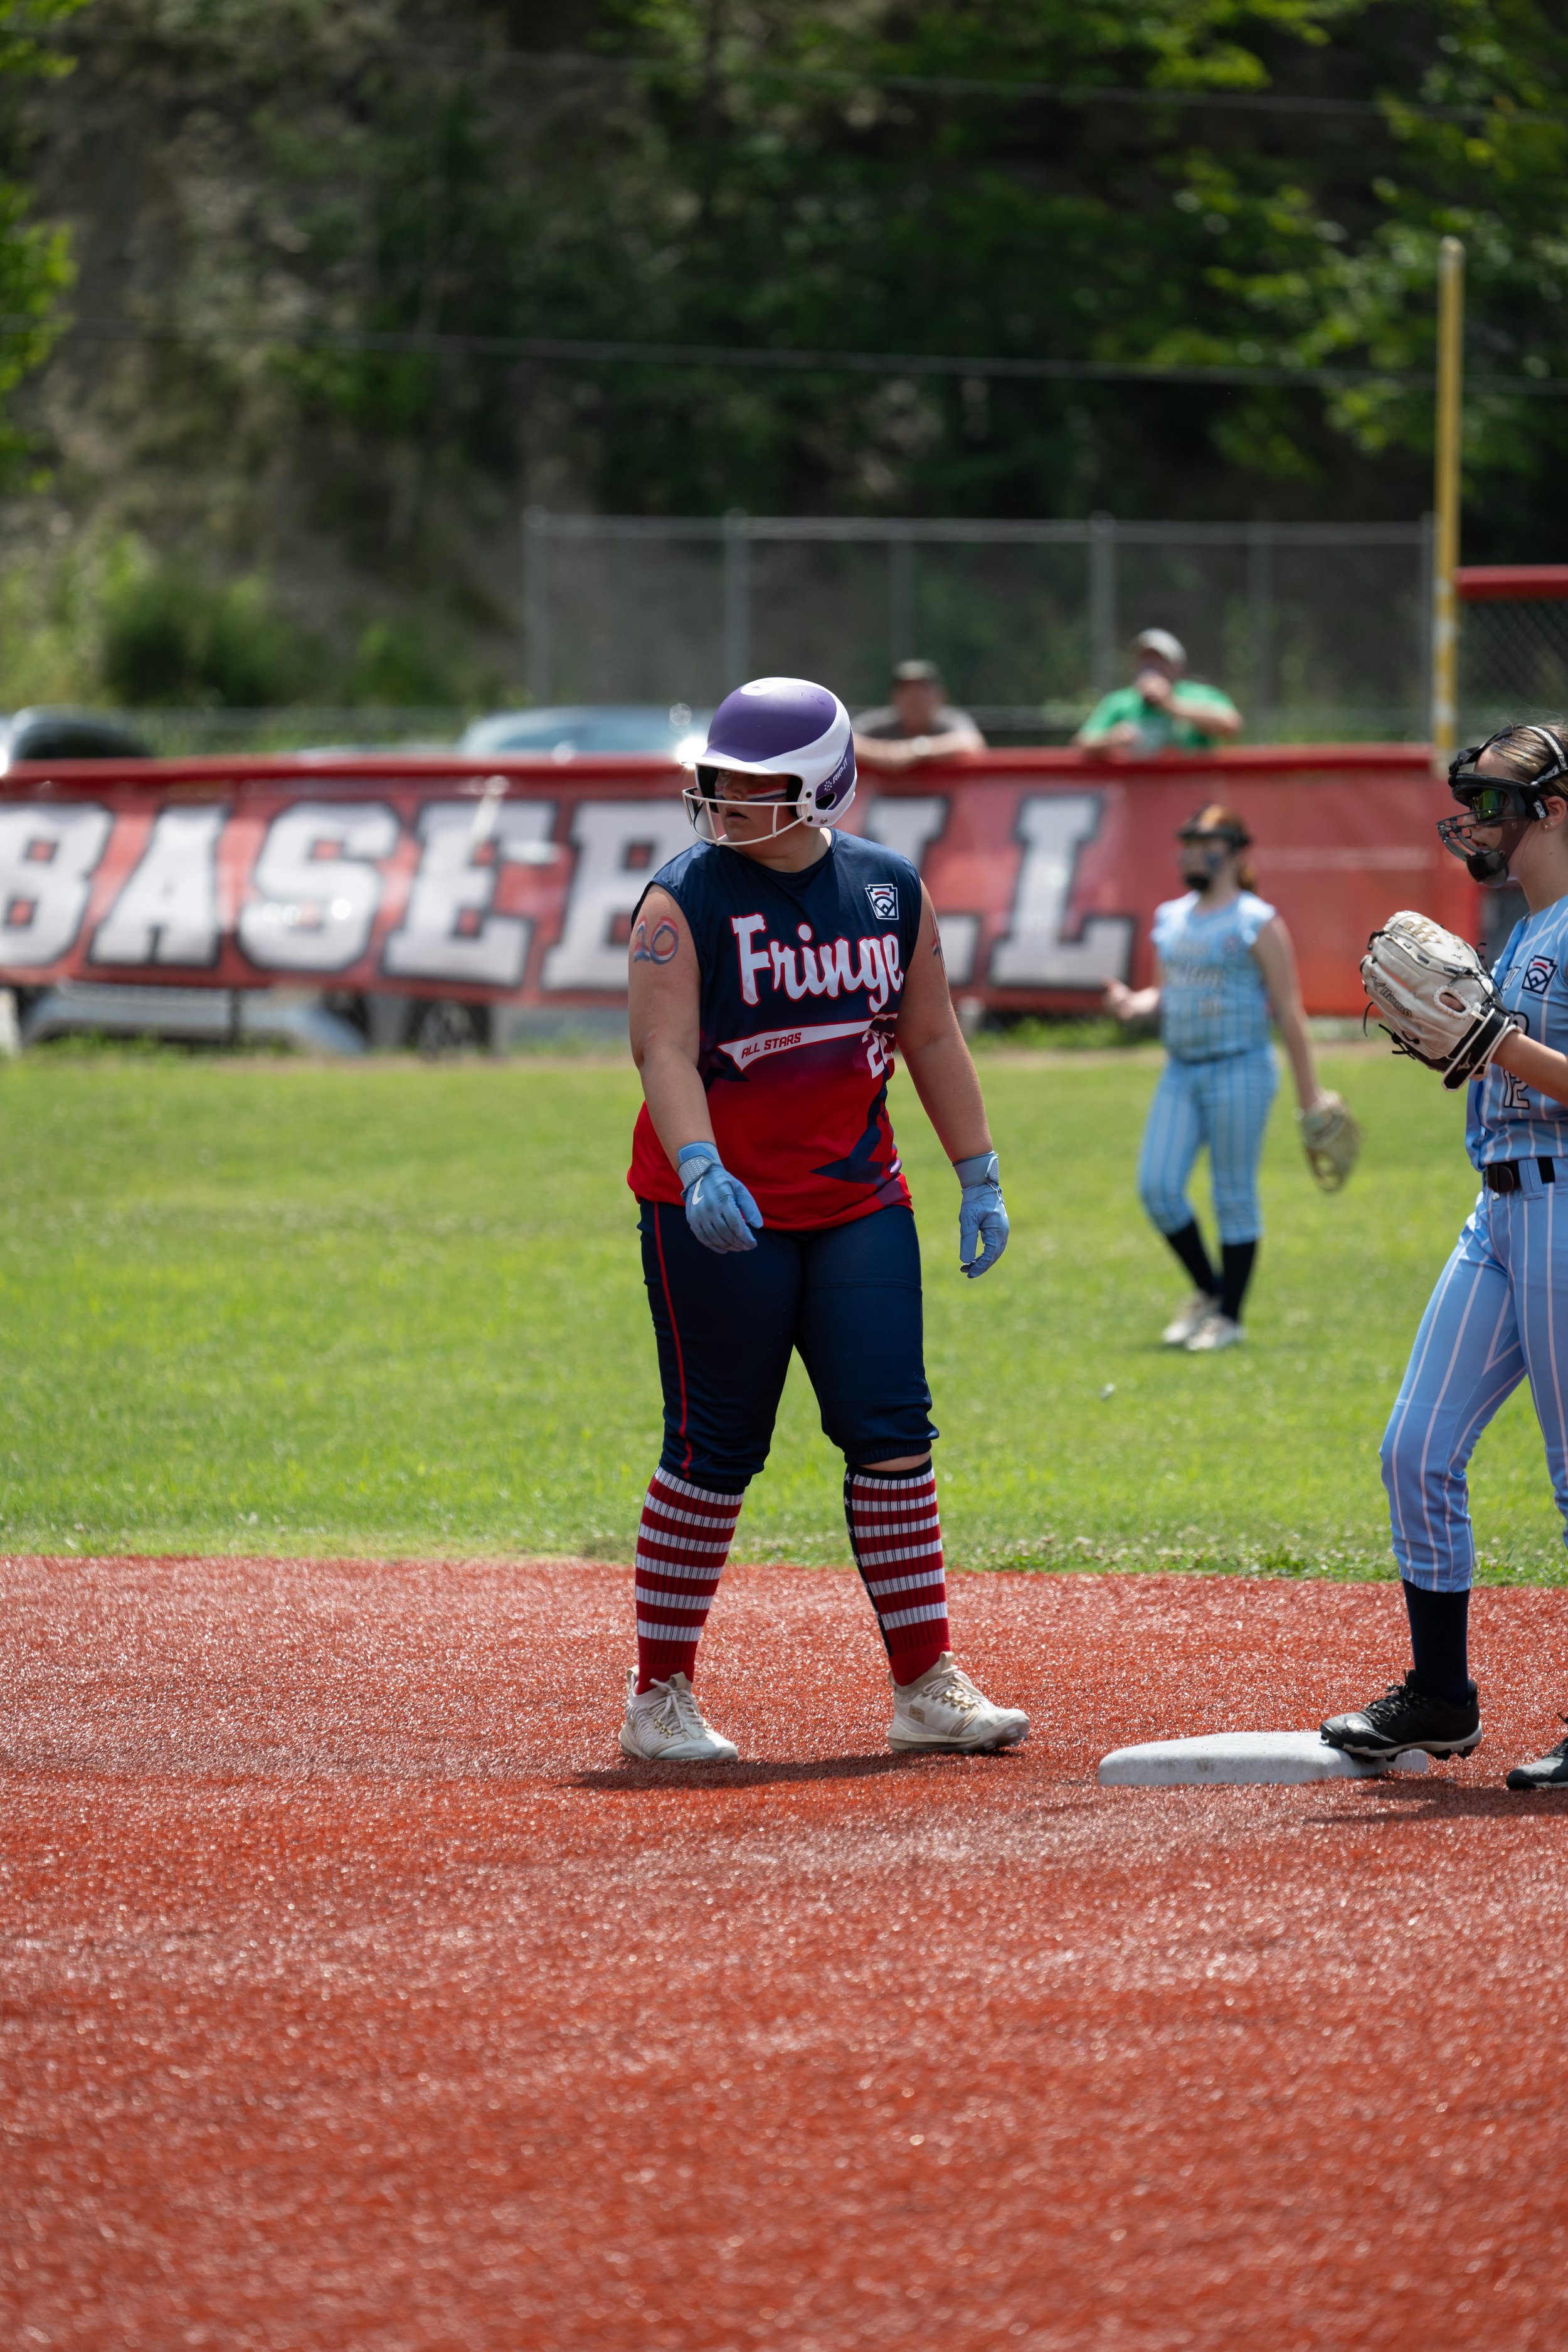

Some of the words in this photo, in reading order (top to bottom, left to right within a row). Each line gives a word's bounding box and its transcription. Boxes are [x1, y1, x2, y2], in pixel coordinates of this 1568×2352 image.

[0, 793, 1138, 991] BASEBL
[729, 911, 904, 1014] Fringe
[741, 1042, 760, 1059] ALL
[763, 1032, 802, 1051] STARS
